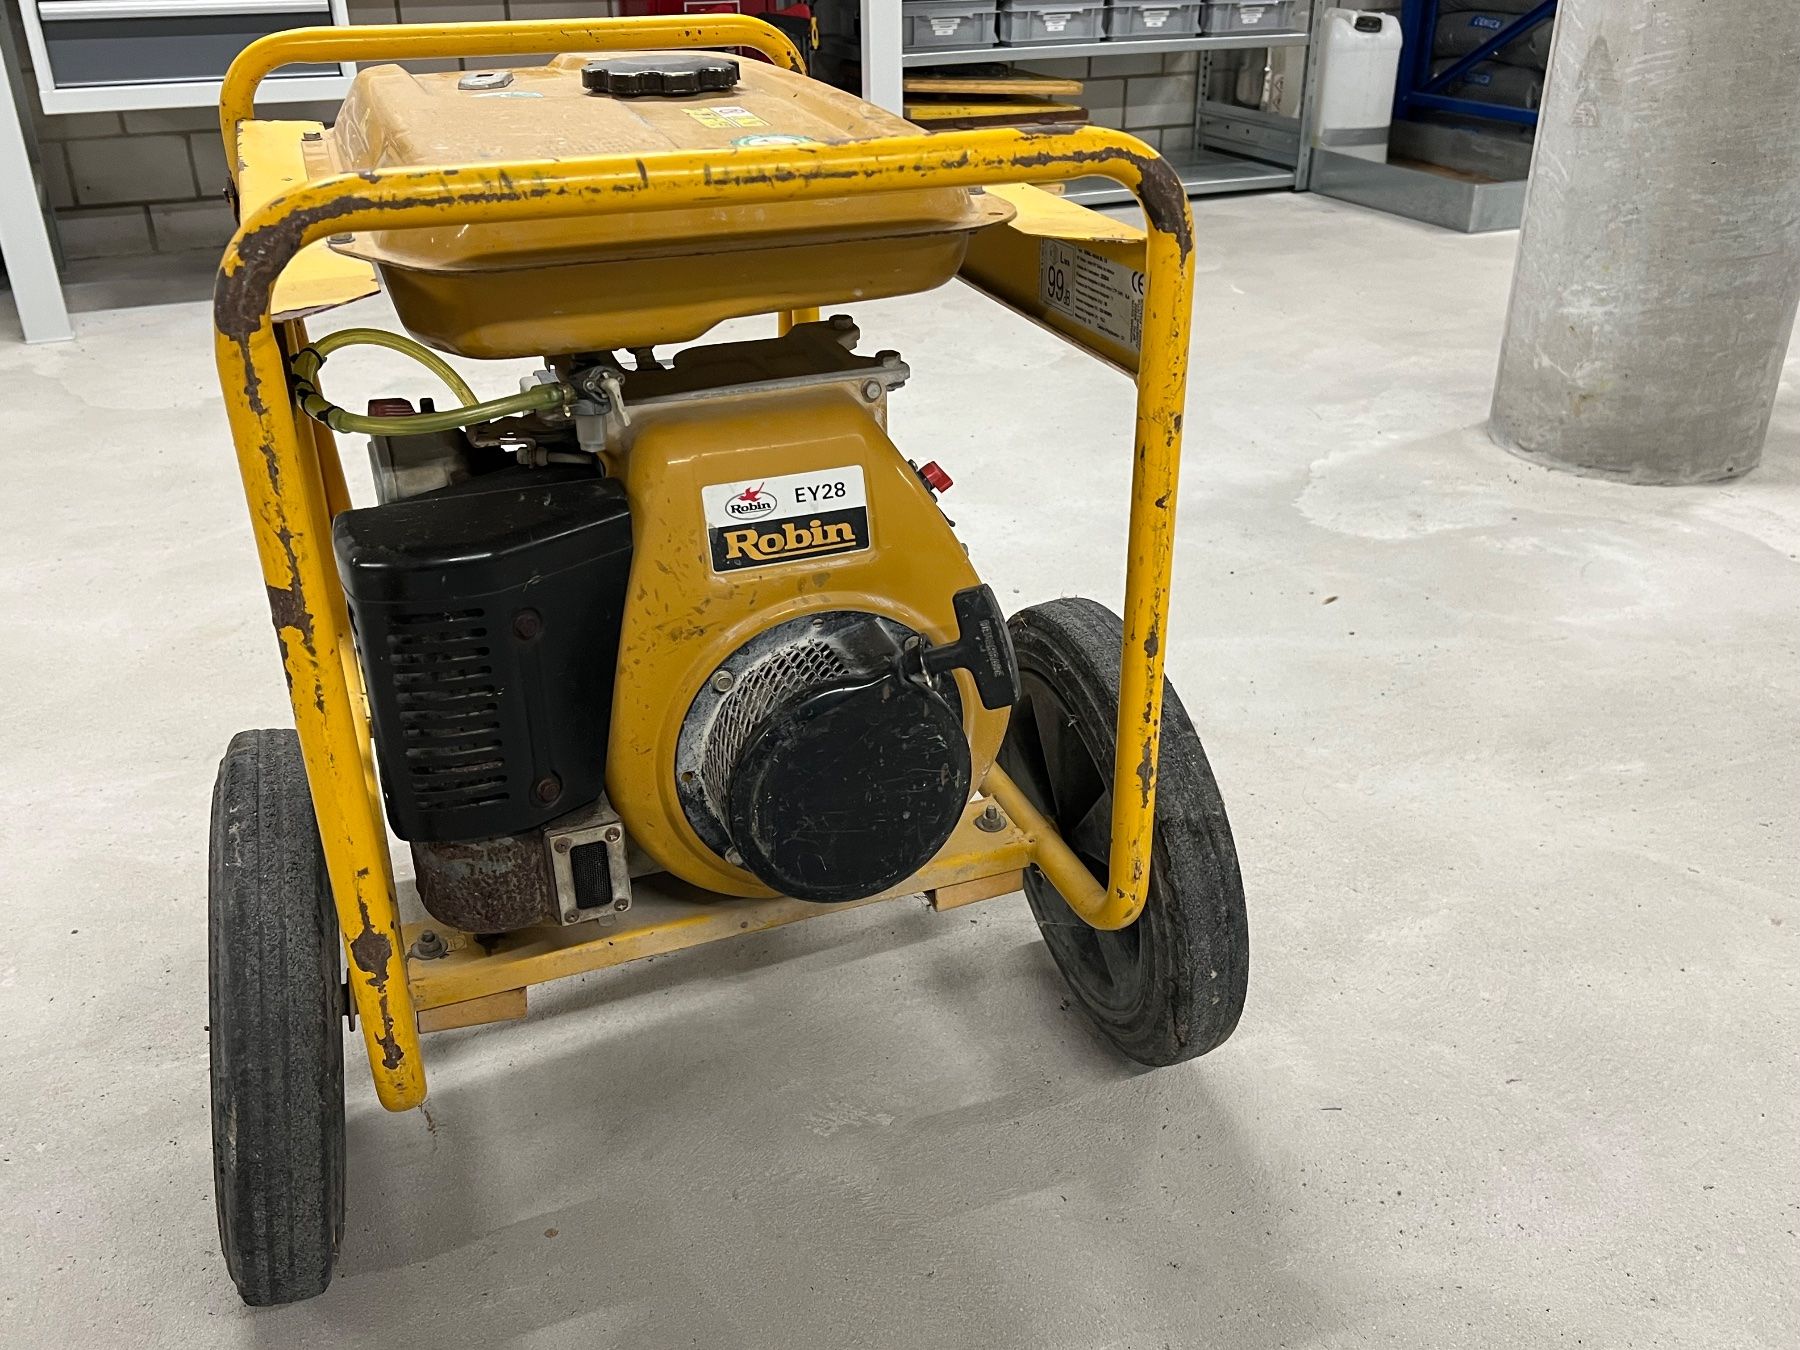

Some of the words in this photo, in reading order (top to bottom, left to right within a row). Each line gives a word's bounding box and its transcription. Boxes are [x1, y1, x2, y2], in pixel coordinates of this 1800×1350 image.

[1048, 265, 1064, 301] 99
[794, 482, 846, 503] EY28
[730, 501, 772, 514] Robin
[723, 519, 857, 561] Robin
